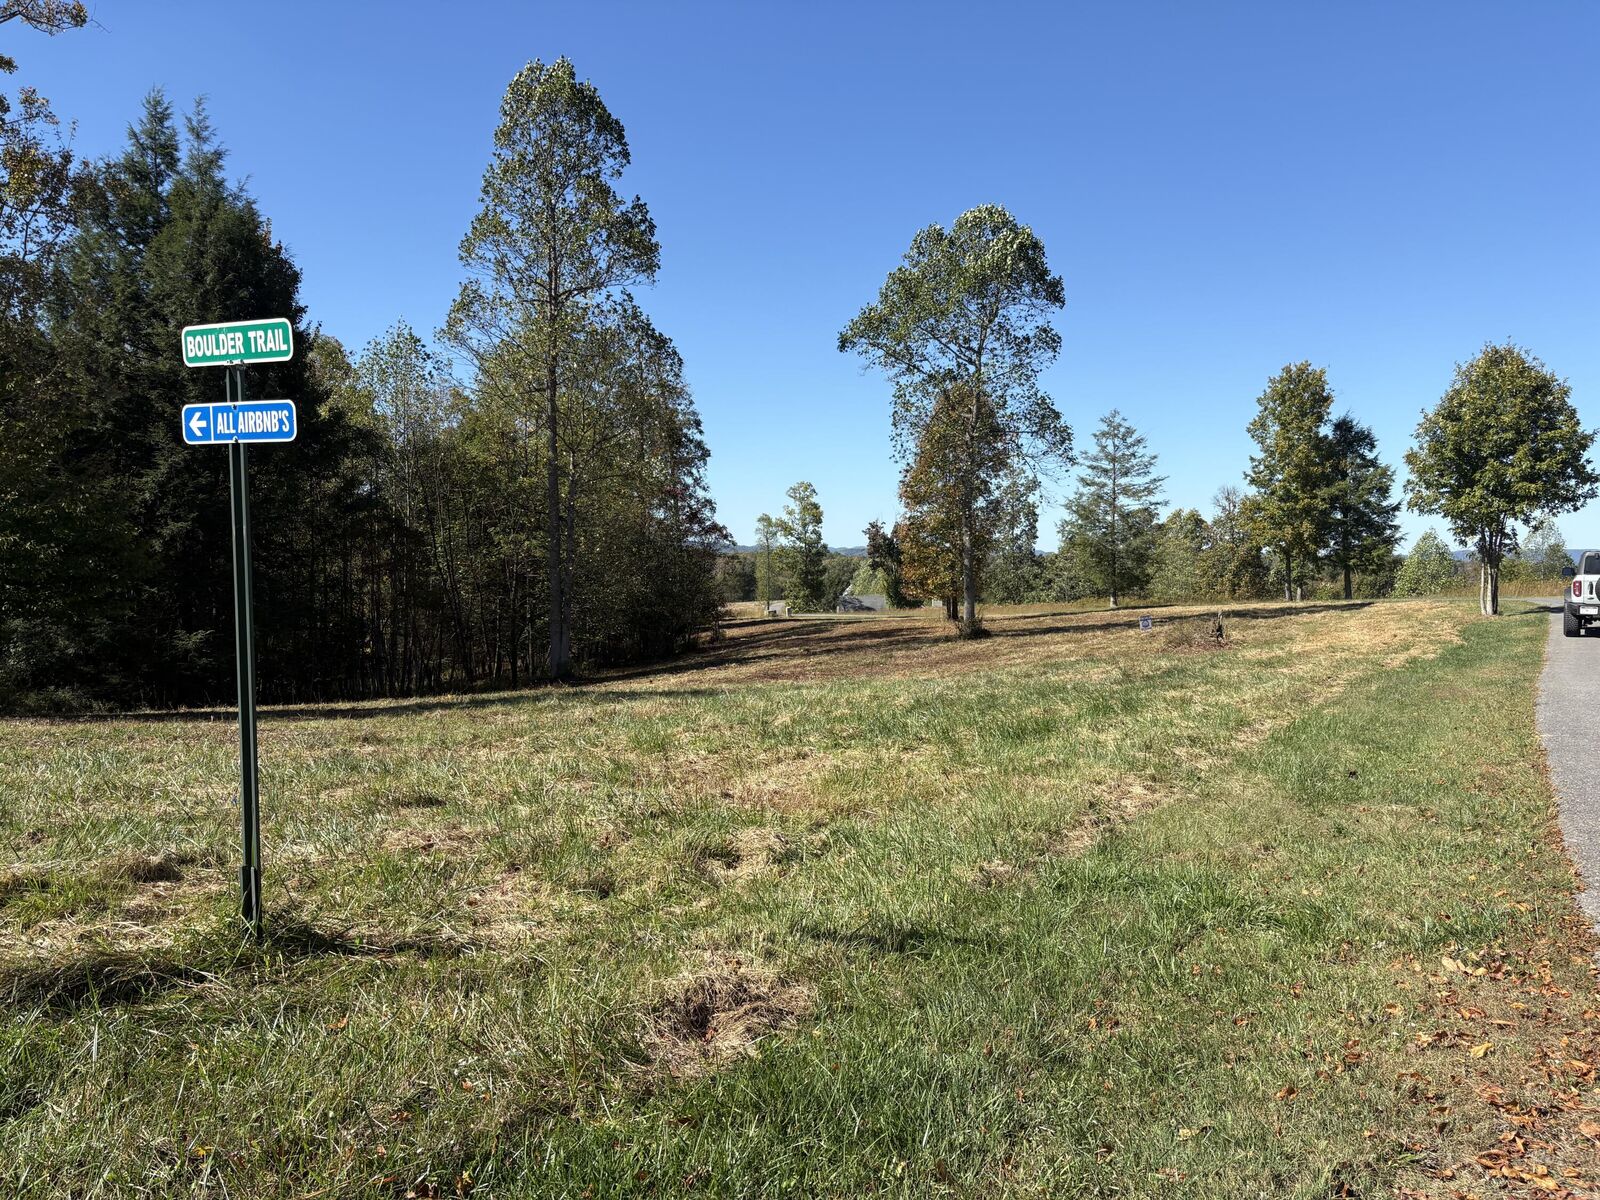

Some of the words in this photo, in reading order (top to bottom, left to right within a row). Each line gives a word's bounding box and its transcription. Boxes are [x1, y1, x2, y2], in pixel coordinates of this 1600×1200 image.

[186, 332, 245, 358] BOULDER
[247, 328, 288, 353] TRAIL
[217, 412, 236, 434] ALL
[238, 409, 290, 434] AIRBNB'S
